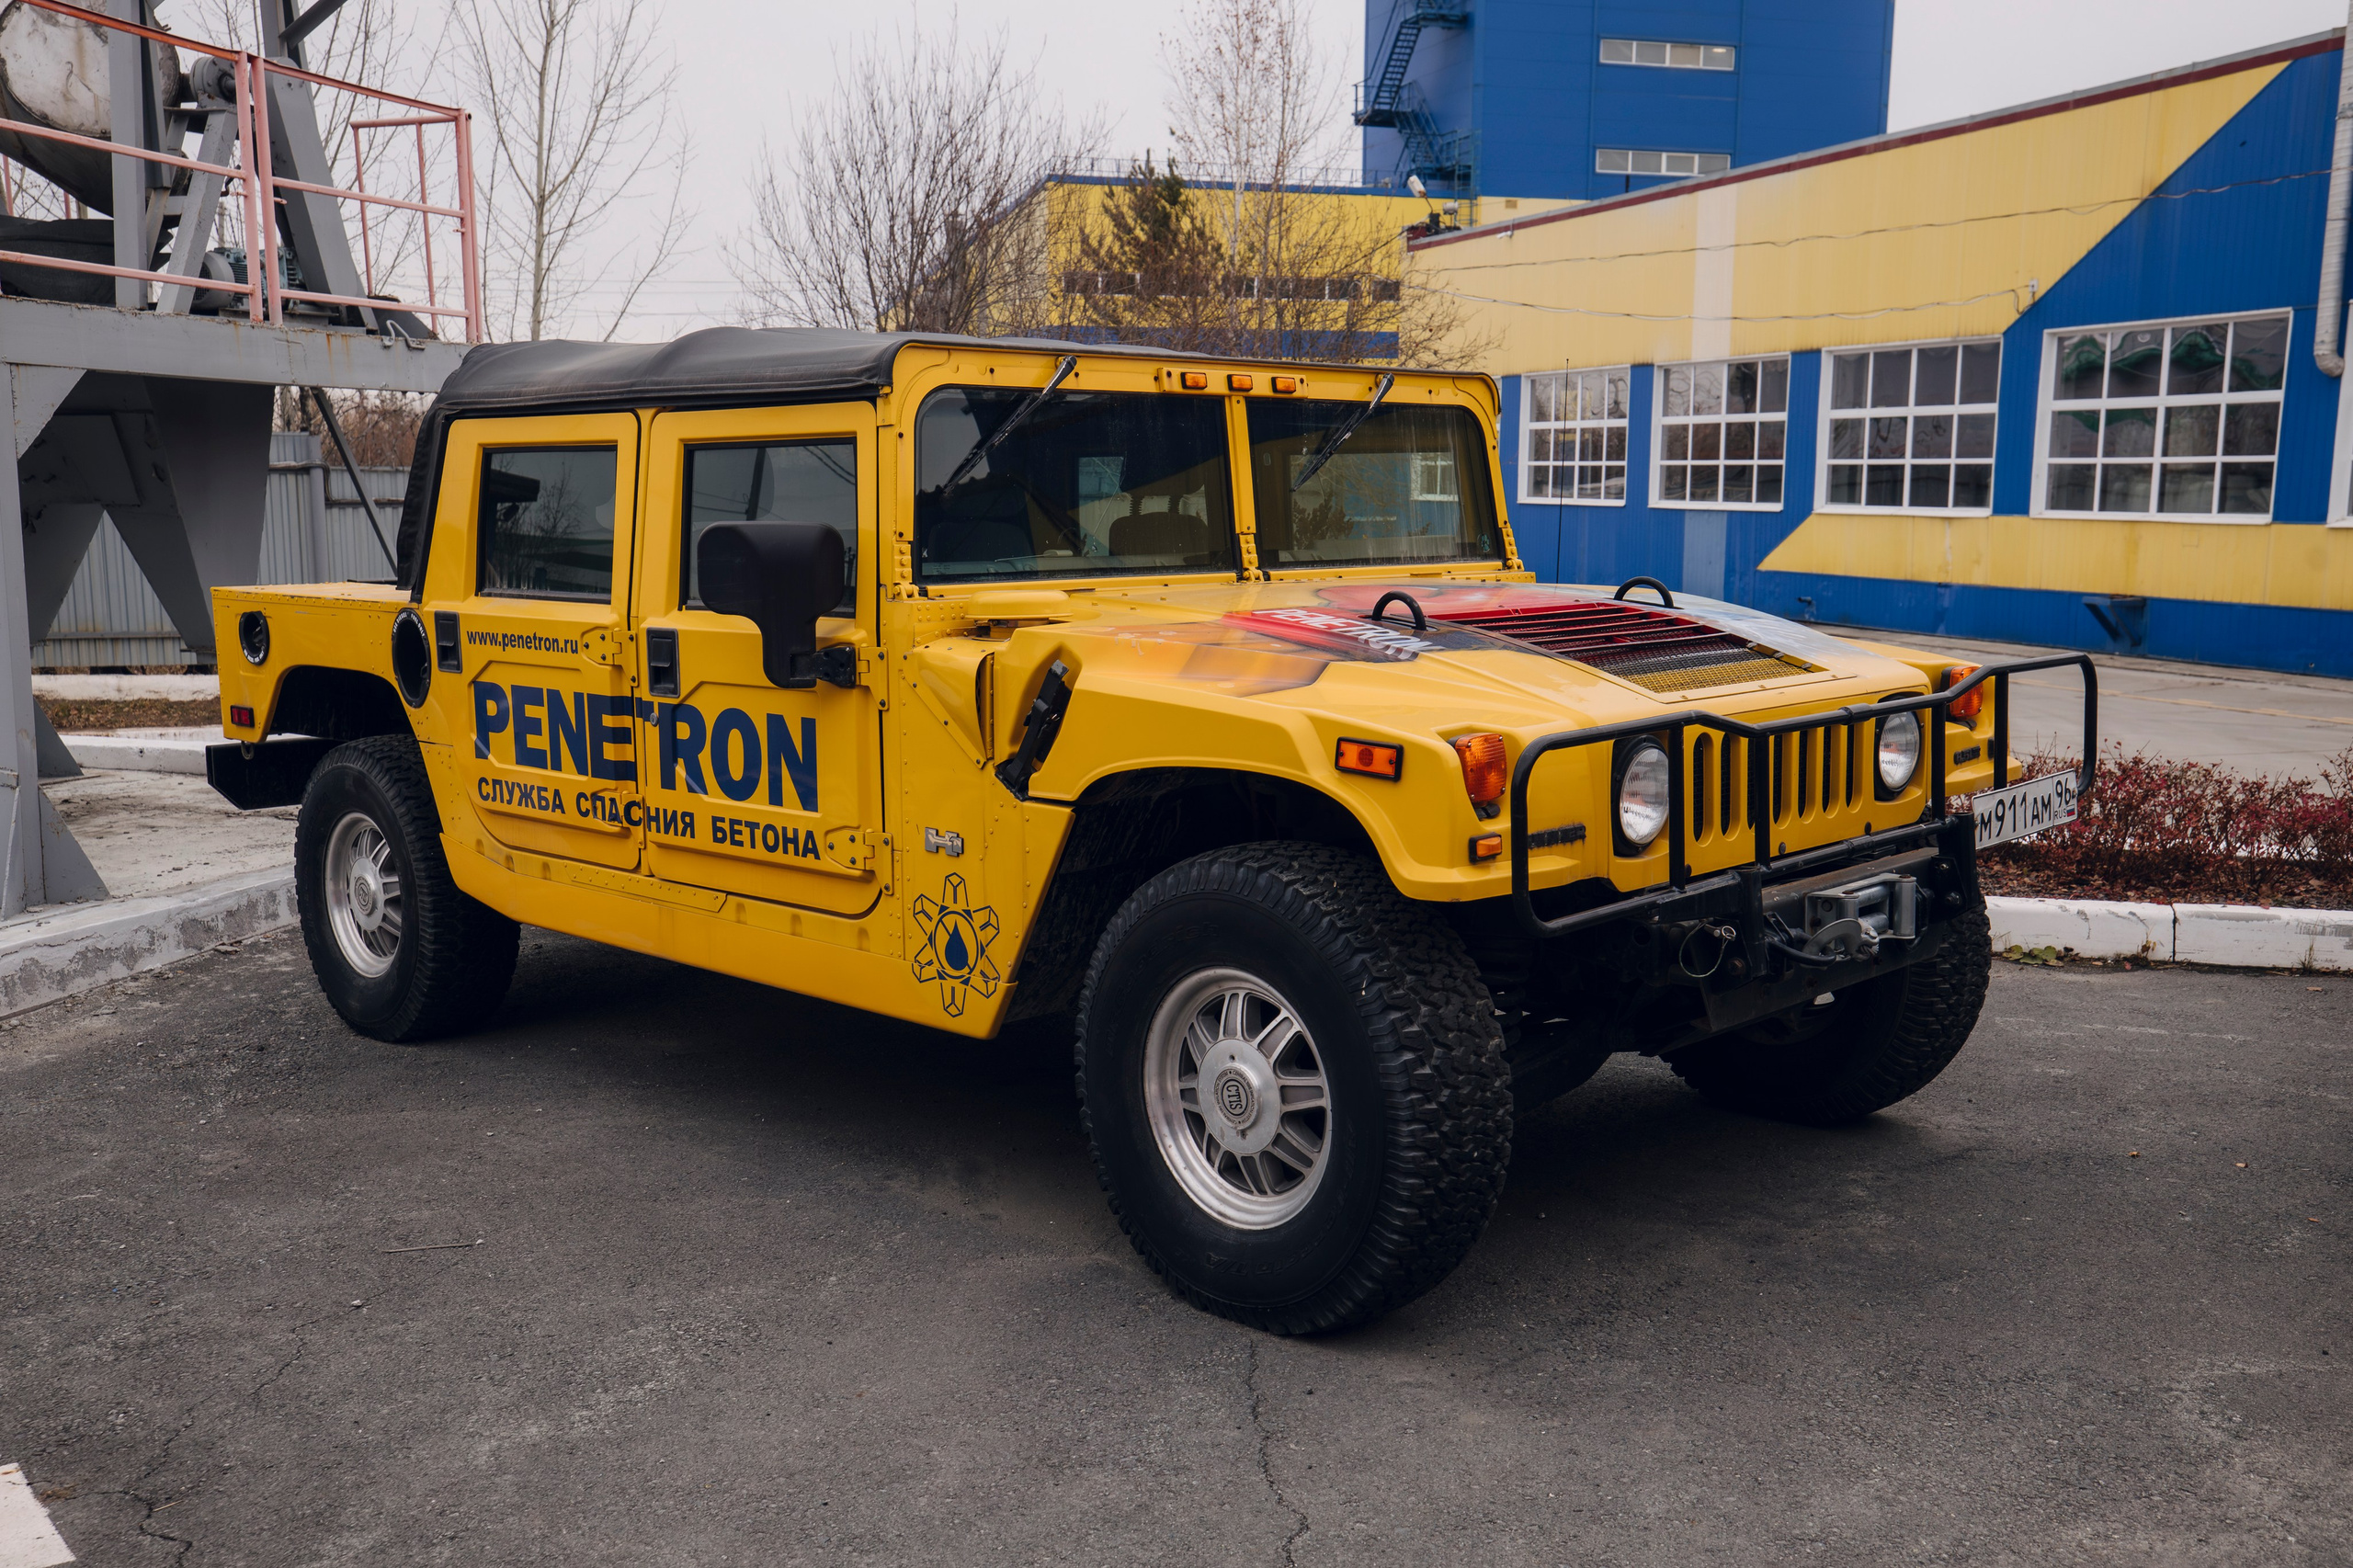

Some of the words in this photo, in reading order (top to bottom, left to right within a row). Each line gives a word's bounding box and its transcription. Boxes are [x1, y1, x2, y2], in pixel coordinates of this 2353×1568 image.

[467, 631, 578, 654] www.penetron.ru
[1253, 608, 1447, 661] PENETRON
[473, 681, 818, 812] PENETRON
[2055, 777, 2071, 808] 96
[477, 777, 566, 814] СЛУЖБА
[711, 815, 822, 861] БЕТОНА
[2054, 808, 2067, 820] RUS
[1226, 1085, 1243, 1110] CTIS
